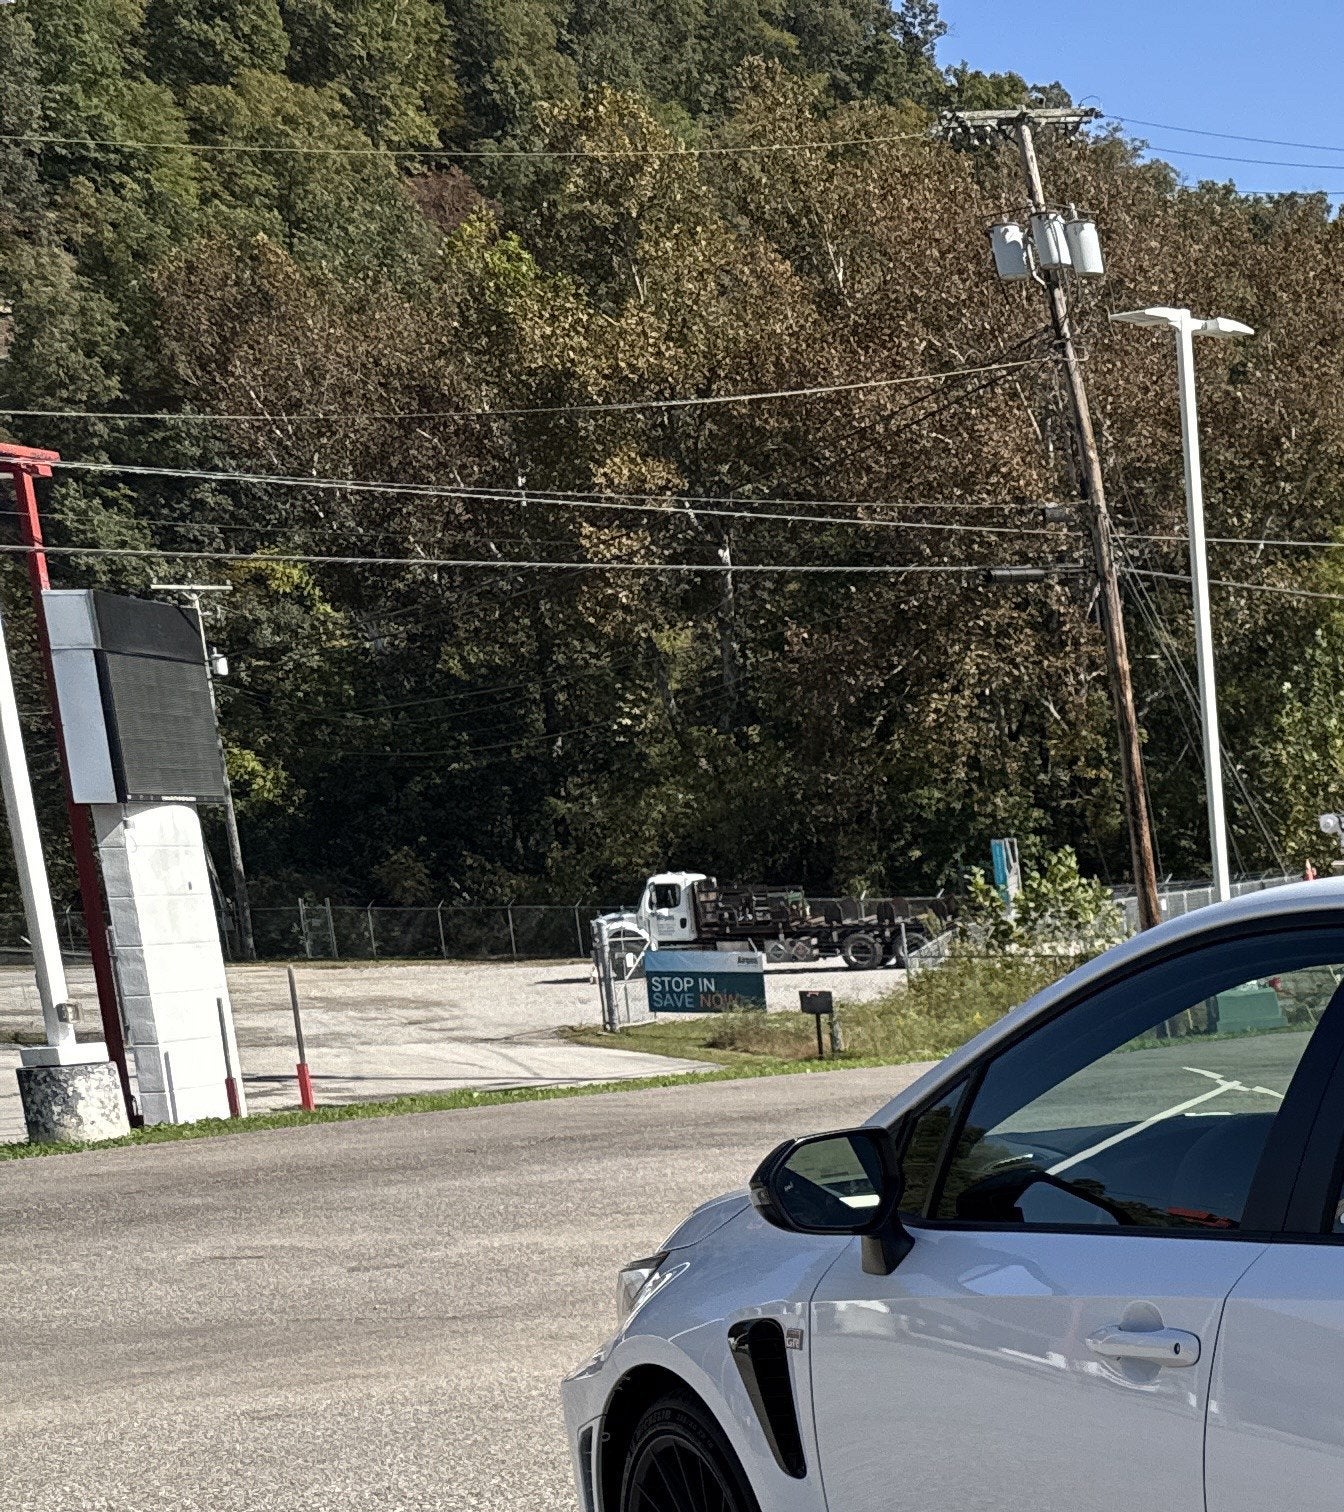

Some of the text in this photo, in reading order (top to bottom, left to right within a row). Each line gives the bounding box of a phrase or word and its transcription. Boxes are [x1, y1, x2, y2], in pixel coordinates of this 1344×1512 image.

[651, 976, 716, 992] STOP IN
[652, 993, 695, 1008] SAVE
